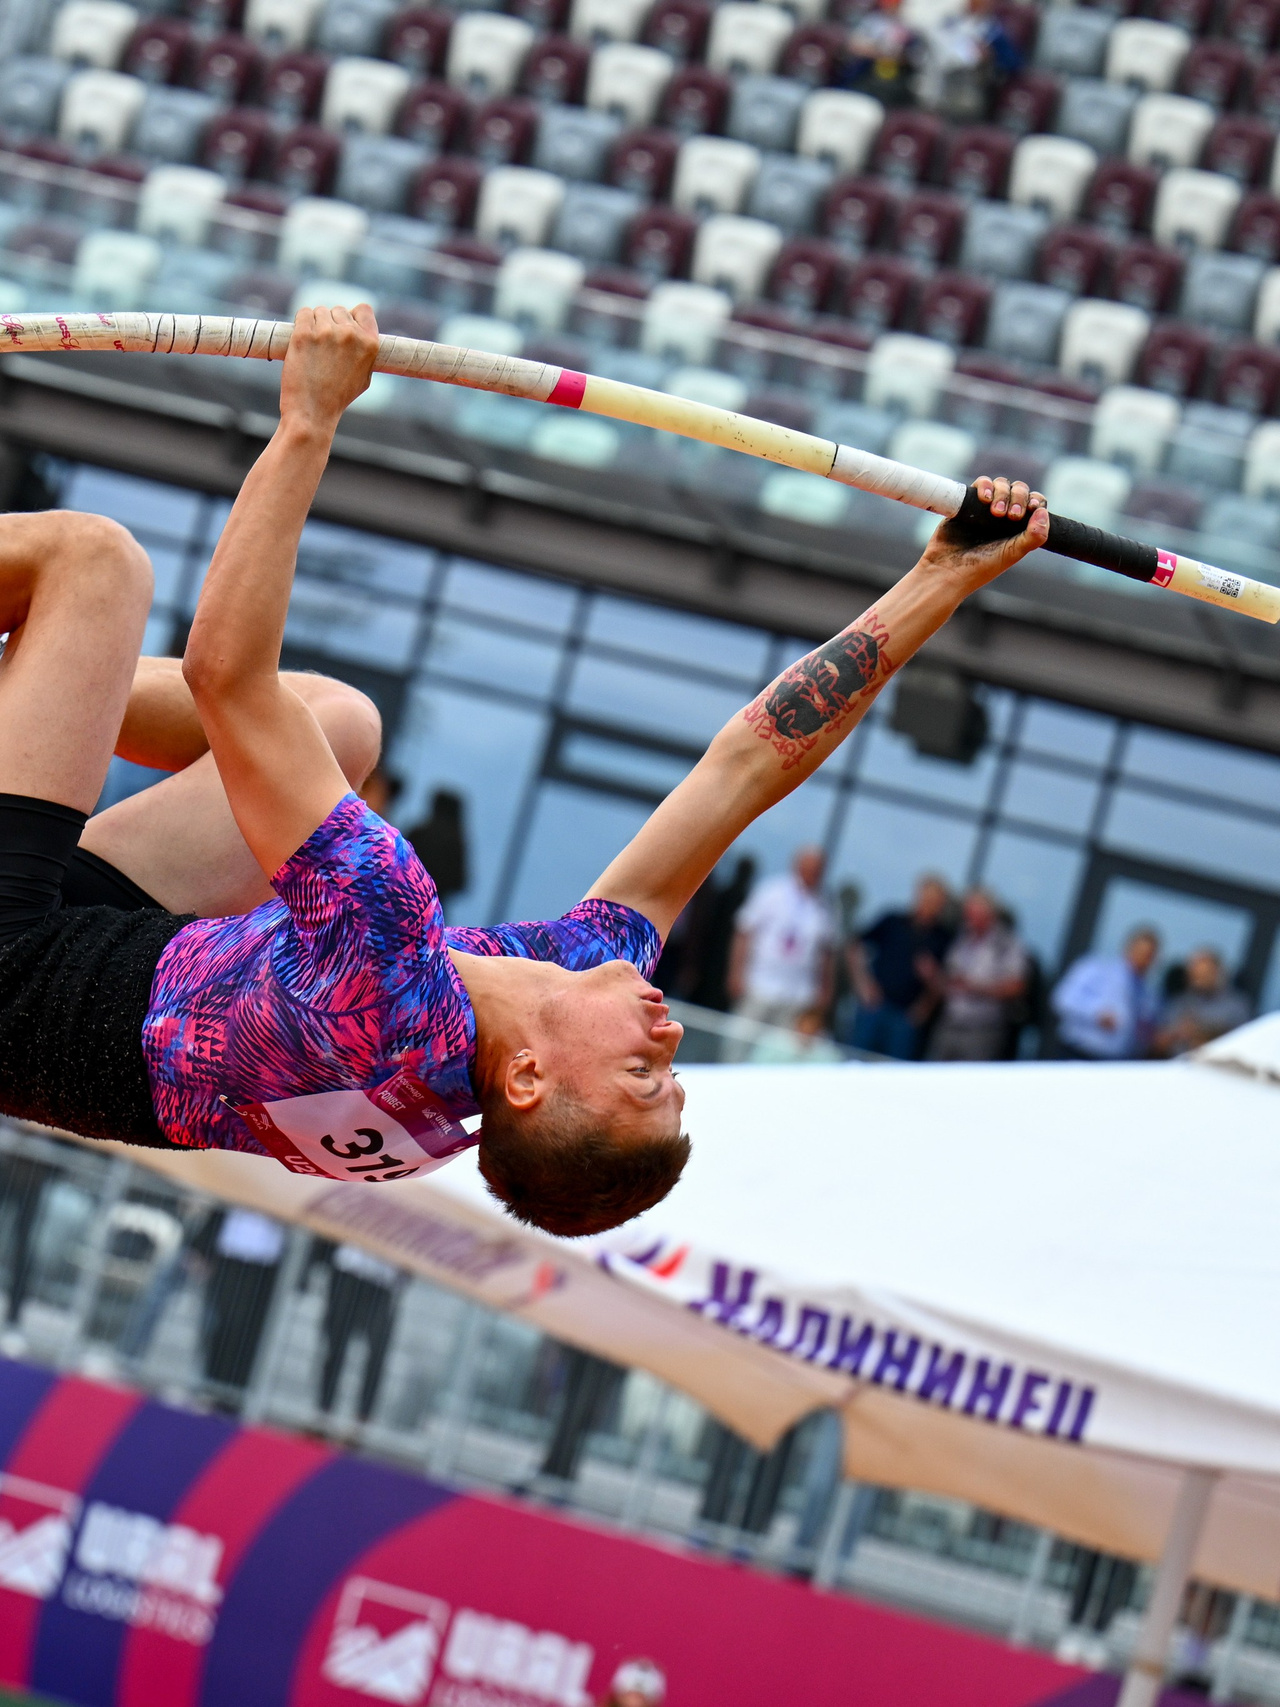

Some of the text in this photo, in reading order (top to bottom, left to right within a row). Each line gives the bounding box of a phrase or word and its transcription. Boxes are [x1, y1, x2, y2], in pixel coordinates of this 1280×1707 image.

[377, 1089, 407, 1112] FONBET
[434, 1113, 454, 1136] URAL
[284, 1155, 325, 1178] U2
